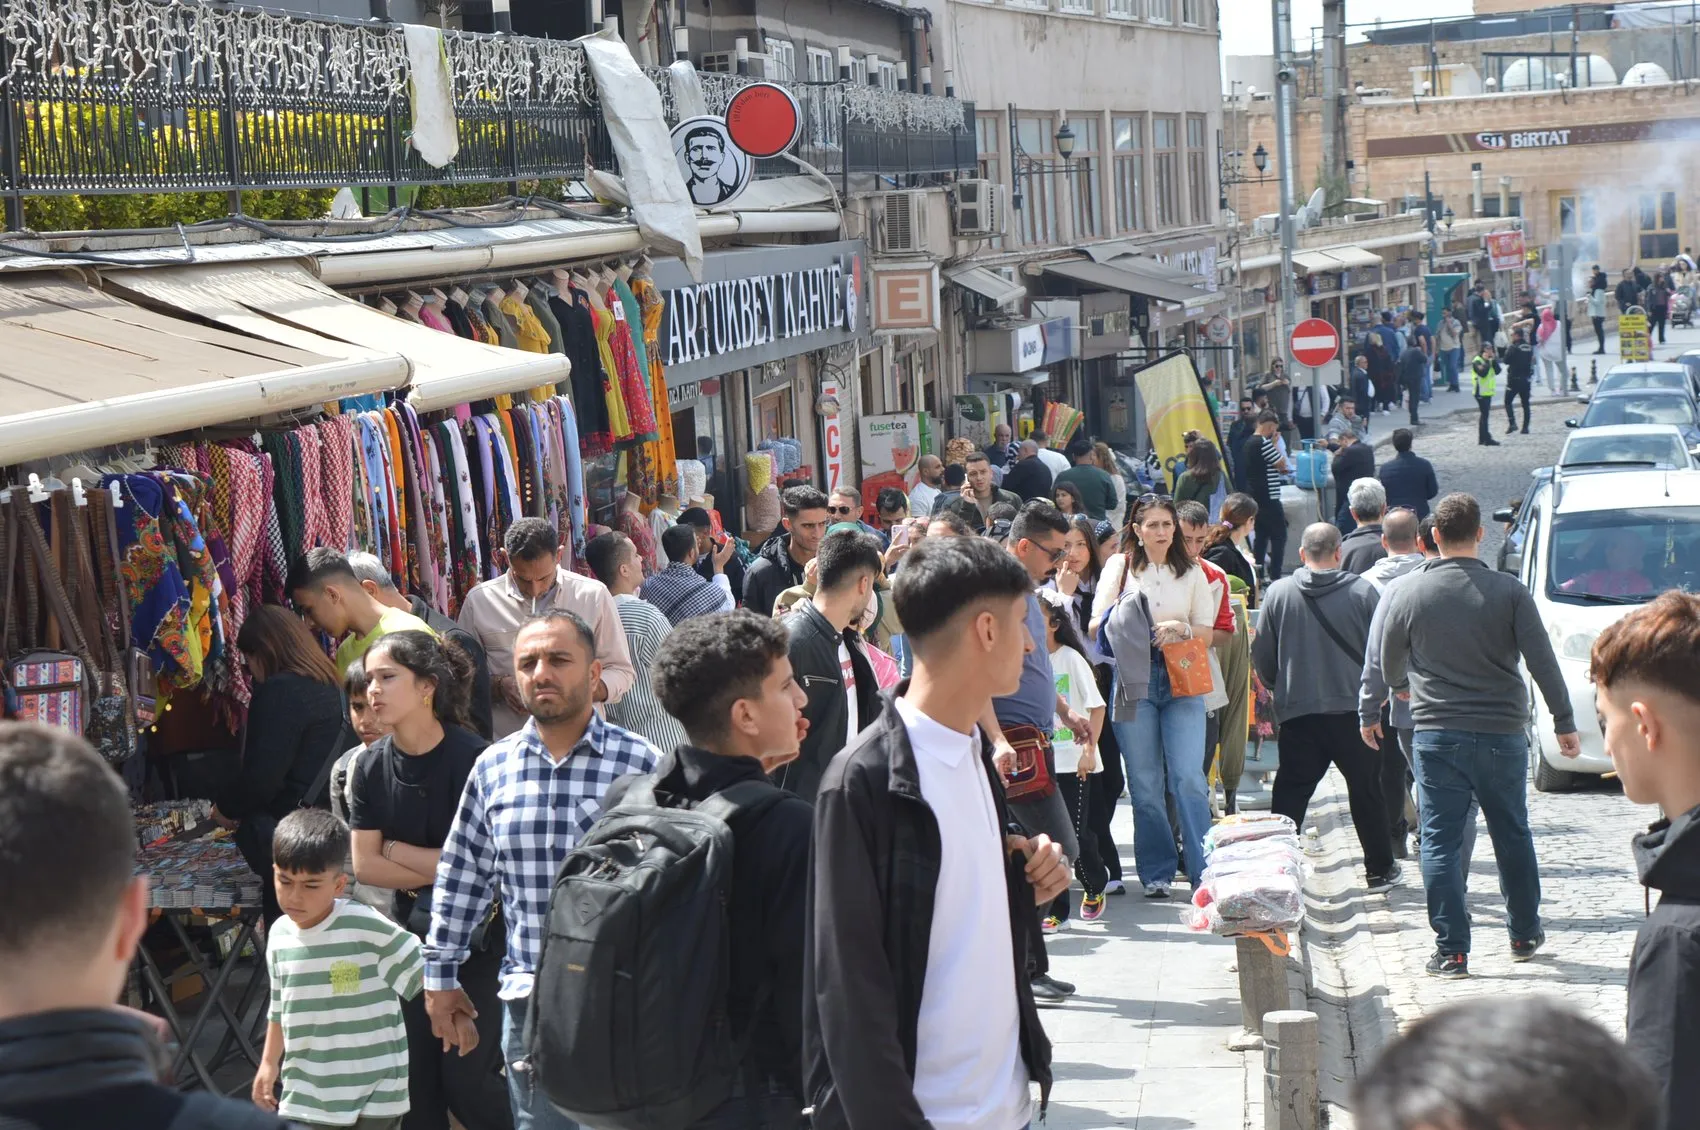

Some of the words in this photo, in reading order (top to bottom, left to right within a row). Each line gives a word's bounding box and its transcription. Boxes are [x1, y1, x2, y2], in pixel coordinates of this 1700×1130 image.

[667, 274, 776, 367] ARTUKBEY
[781, 264, 844, 339] KAHVE
[887, 278, 922, 319] E
[869, 421, 907, 431] fusetea
